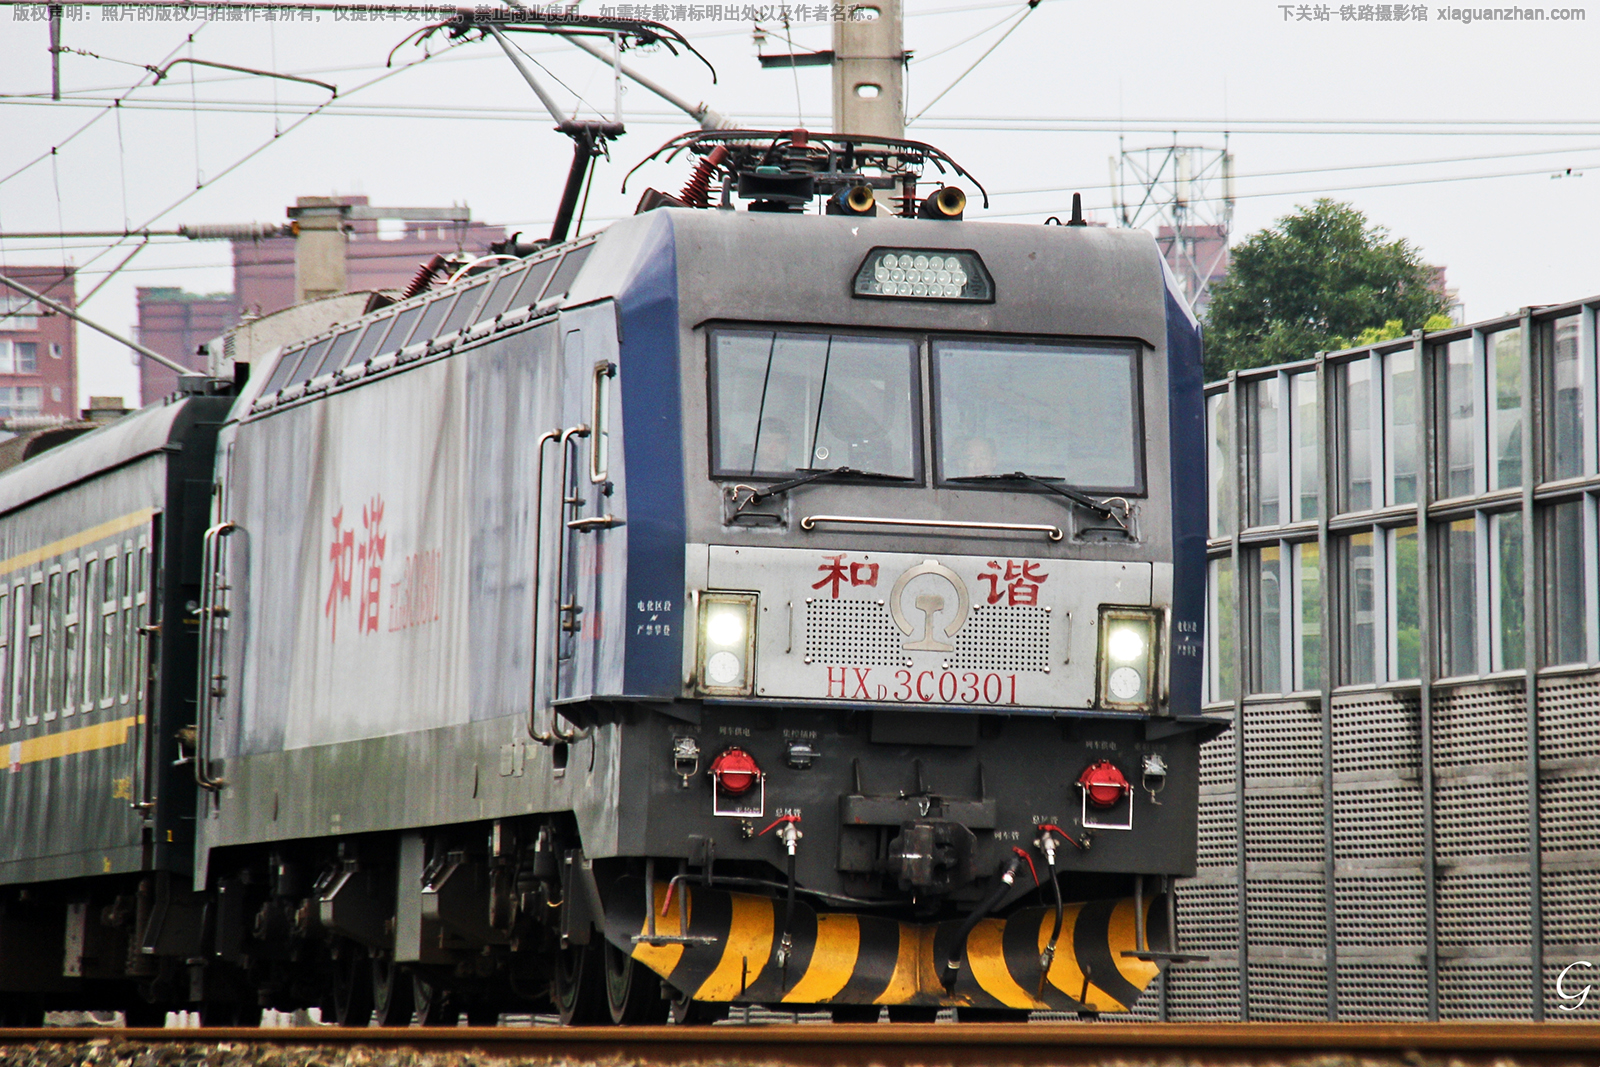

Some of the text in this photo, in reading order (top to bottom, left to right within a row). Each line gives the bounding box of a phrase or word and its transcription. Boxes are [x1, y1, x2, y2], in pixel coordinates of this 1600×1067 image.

[325, 492, 387, 644] 和谐
[811, 552, 1049, 608] 和 谐
[637, 599, 672, 612] 电化区段
[825, 666, 1021, 706] HXD3C0301
